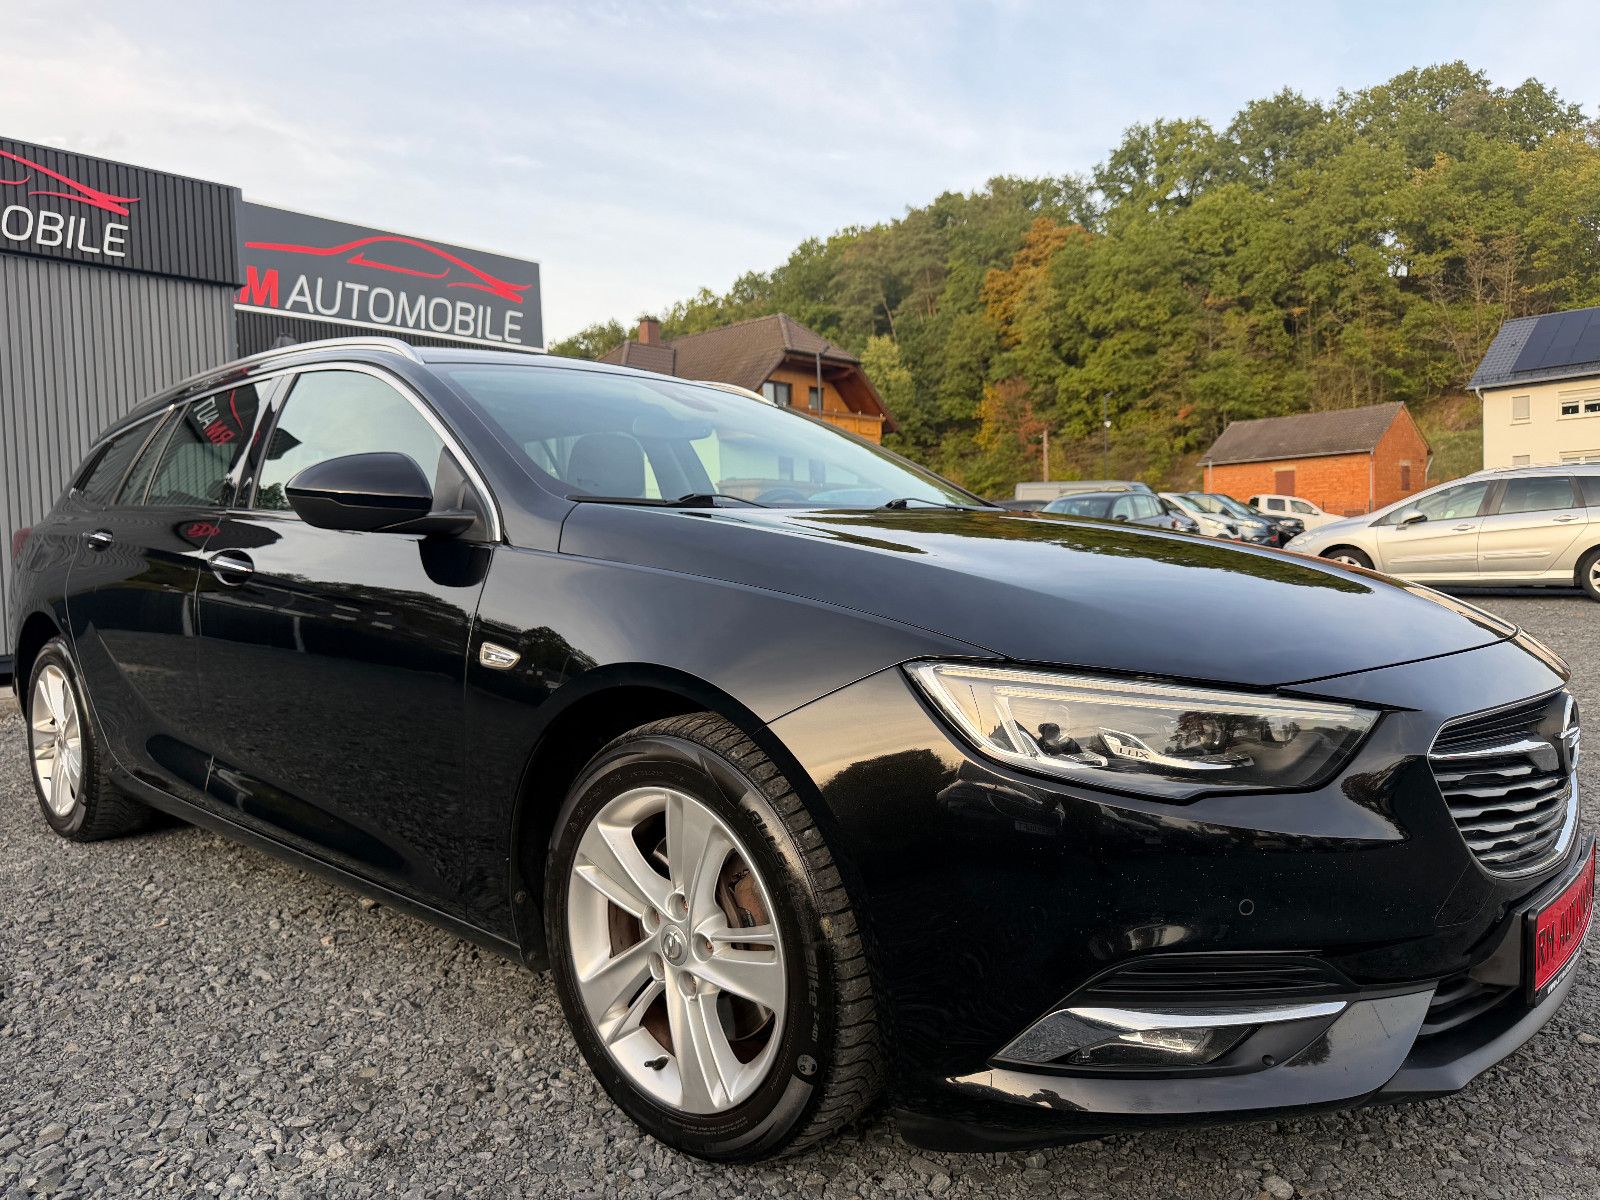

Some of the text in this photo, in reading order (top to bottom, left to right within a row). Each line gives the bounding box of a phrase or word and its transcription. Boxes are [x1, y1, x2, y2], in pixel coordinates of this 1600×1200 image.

[2, 205, 129, 257] OBILE
[233, 265, 524, 343] M AUTOMOBILE
[1538, 921, 1555, 970] RM
